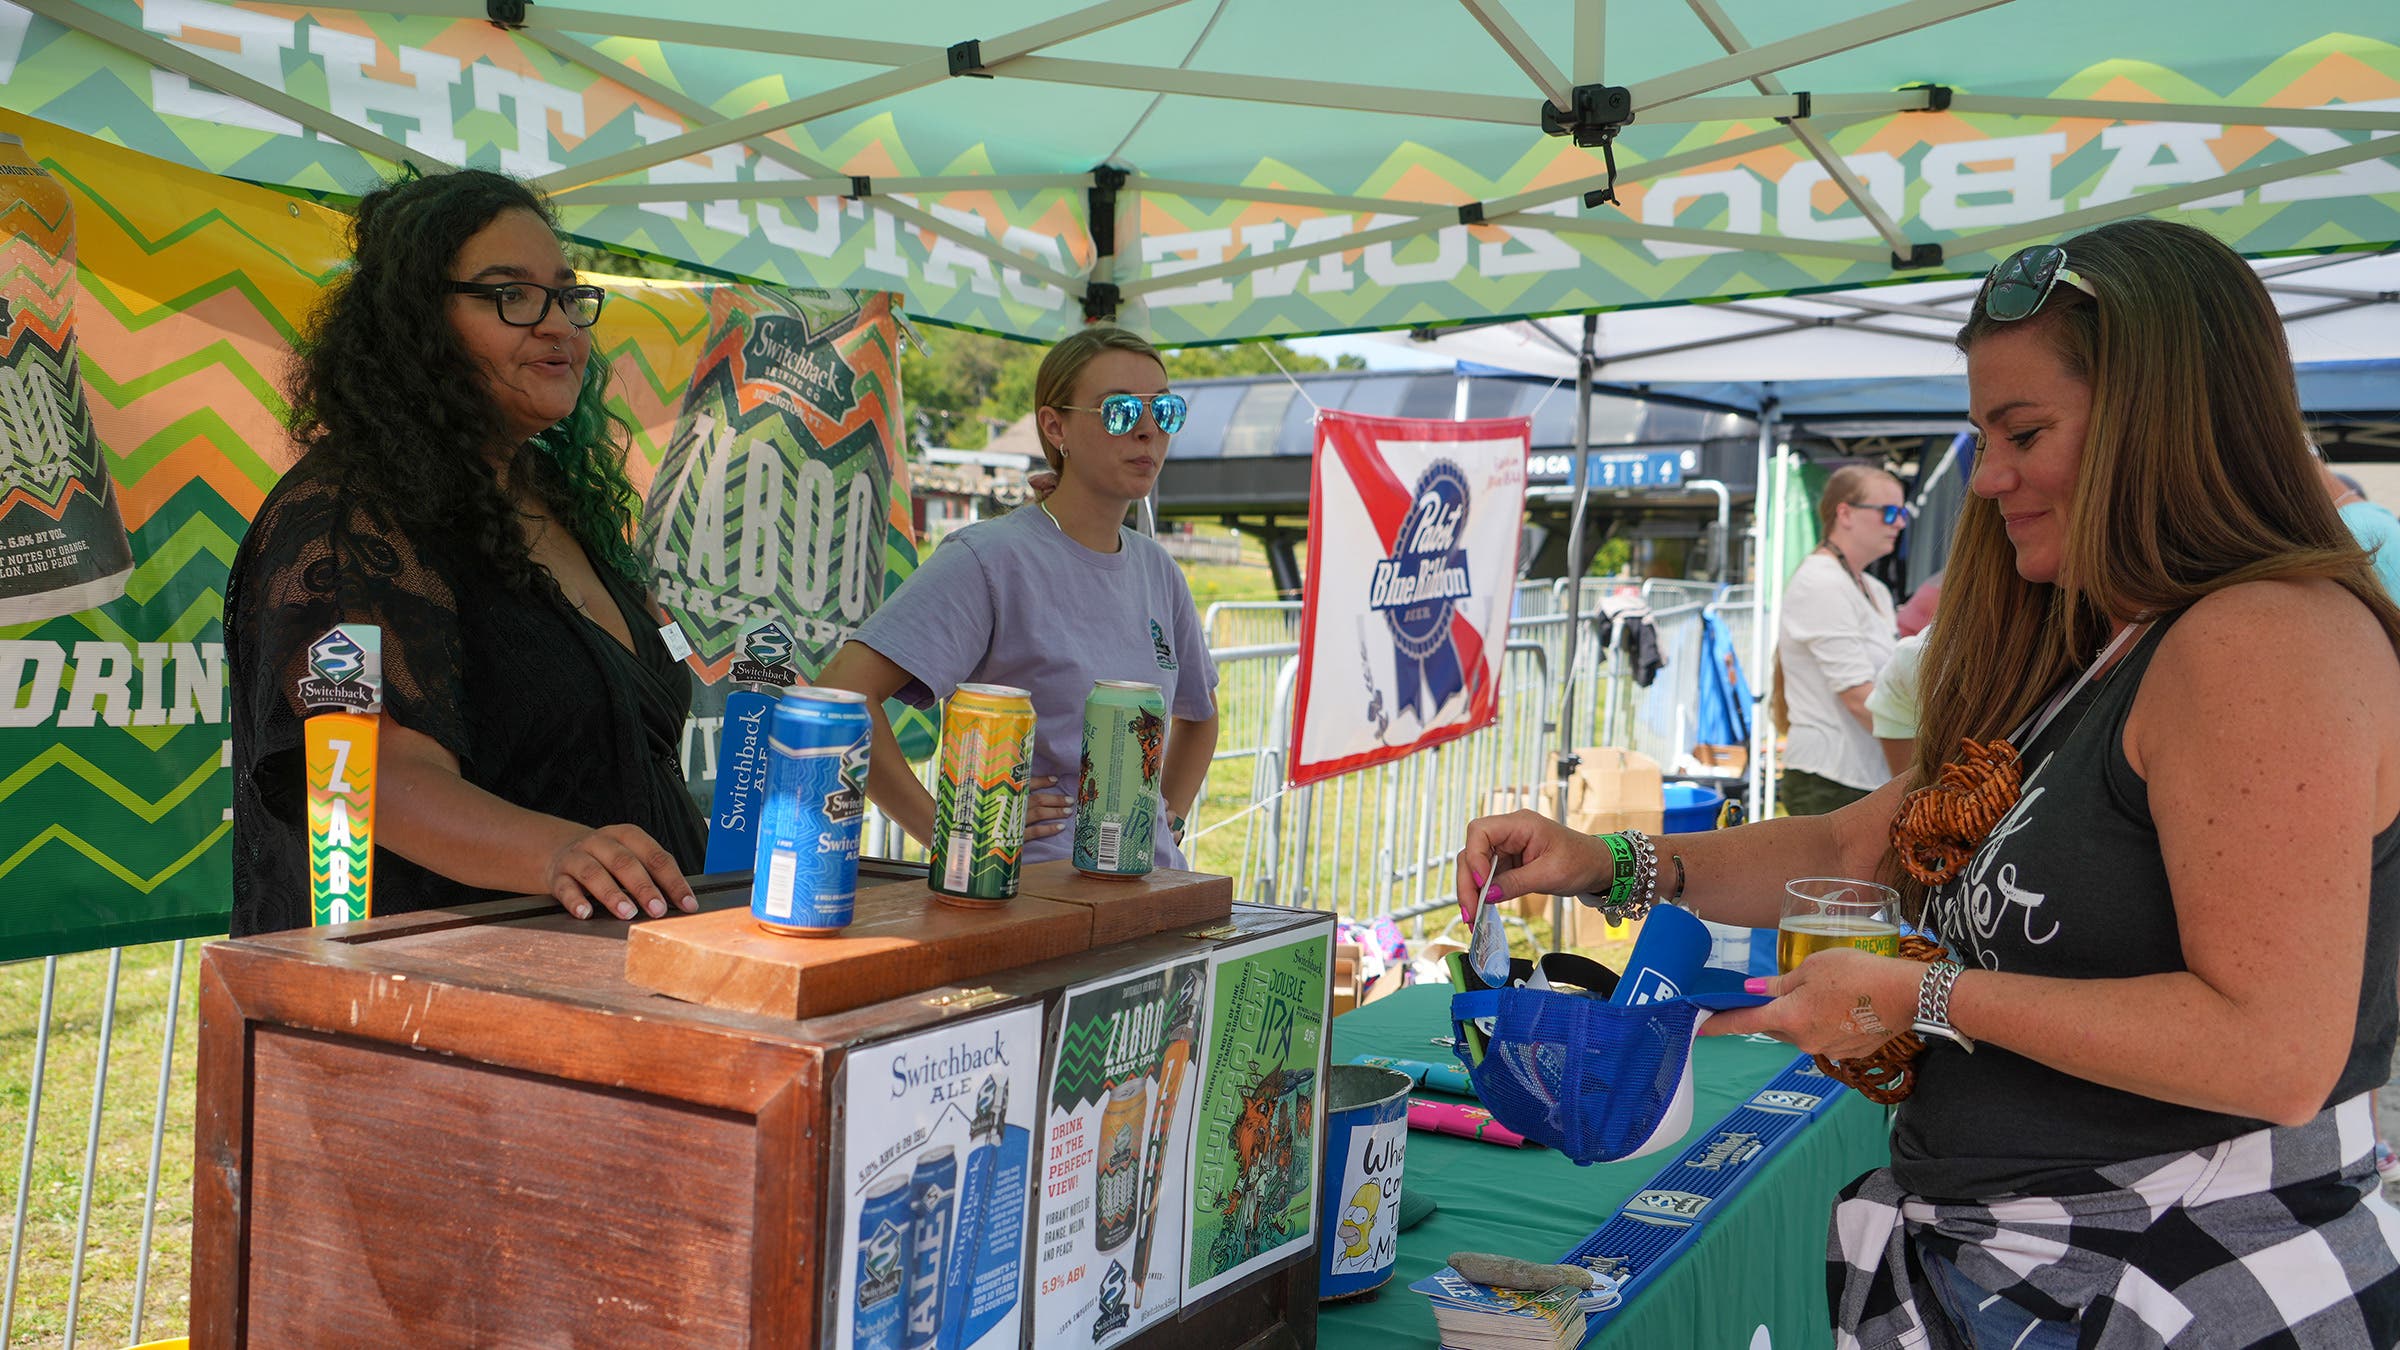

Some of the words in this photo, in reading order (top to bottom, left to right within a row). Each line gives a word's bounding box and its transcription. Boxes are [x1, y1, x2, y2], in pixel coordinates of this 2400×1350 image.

[753, 321, 845, 401] Switchback
[654, 413, 873, 622] ZABOO
[1409, 491, 1464, 554] Pabst
[7, 534, 35, 549] 5.9%
[35, 530, 49, 544] BY
[7, 550, 44, 567] NOTES
[45, 547, 57, 559] OF
[58, 540, 90, 556] ORANGE,
[27, 559, 49, 574] AND
[51, 554, 79, 569] PEACH
[1371, 560, 1415, 608] Blue
[1414, 555, 1469, 603] Ribbon
[0, 640, 231, 728] DRIN
[737, 662, 792, 683] Switchback
[305, 682, 369, 701] Switchback
[721, 704, 767, 833] Switchback
[1293, 948, 1324, 978] Switchback
[1269, 968, 1307, 1003] DOUBLE
[1221, 1036, 1235, 1068] LEMON
[1231, 1002, 1243, 1035] SUGAR
[1238, 961, 1251, 1003] COOKIES
[1255, 994, 1296, 1063] IPA
[1104, 998, 1166, 1067] ZABOO
[1202, 1052, 1224, 1112] ENCHANTING
[1220, 1024, 1231, 1053] NOTES
[1231, 983, 1240, 1006] PINE
[891, 1029, 1010, 1101] Switchback
[1105, 1059, 1138, 1079] HAZY
[1139, 1052, 1157, 1067] IPA
[930, 1077, 972, 1104] ALE
[1052, 1116, 1084, 1142] DRINK
[1050, 1144, 1064, 1161] IN
[1065, 1134, 1085, 1156] THE
[1048, 1148, 1095, 1181] PERFECT
[1048, 1174, 1080, 1199] VIEW!
[1045, 1203, 1069, 1227] VIBRANT
[1043, 1247, 1056, 1263] AND
[1055, 1239, 1074, 1260] PEACH
[907, 1209, 946, 1337] ALE
[1041, 1272, 1065, 1296] 5.9%
[1066, 1263, 1087, 1286] ABV
[1095, 1305, 1128, 1334] Switchback
